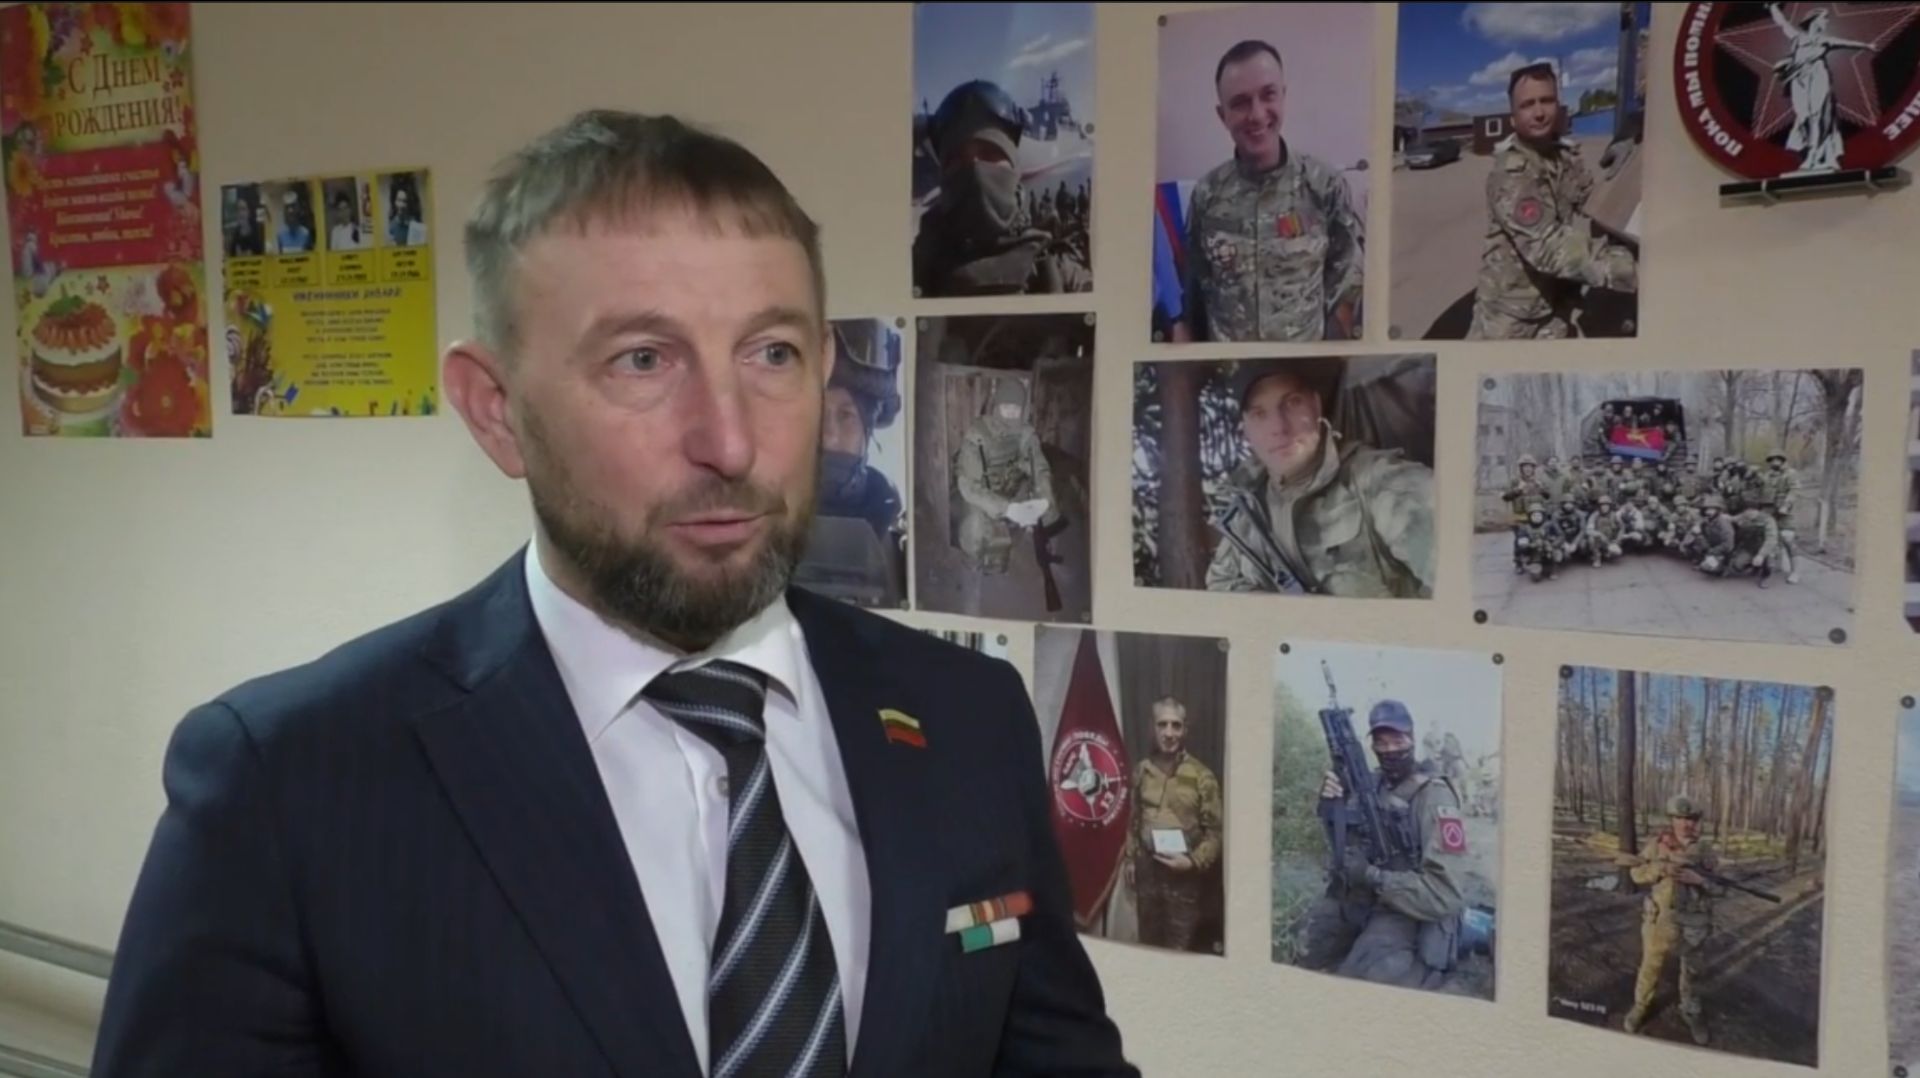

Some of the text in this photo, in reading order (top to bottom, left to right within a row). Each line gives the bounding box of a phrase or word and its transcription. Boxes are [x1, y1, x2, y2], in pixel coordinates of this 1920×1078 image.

[68, 57, 86, 94] С
[1684, 2, 1743, 156] ПОКА МЫ ПОМН
[55, 96, 182, 137] РОЖДЕНИЯ!
